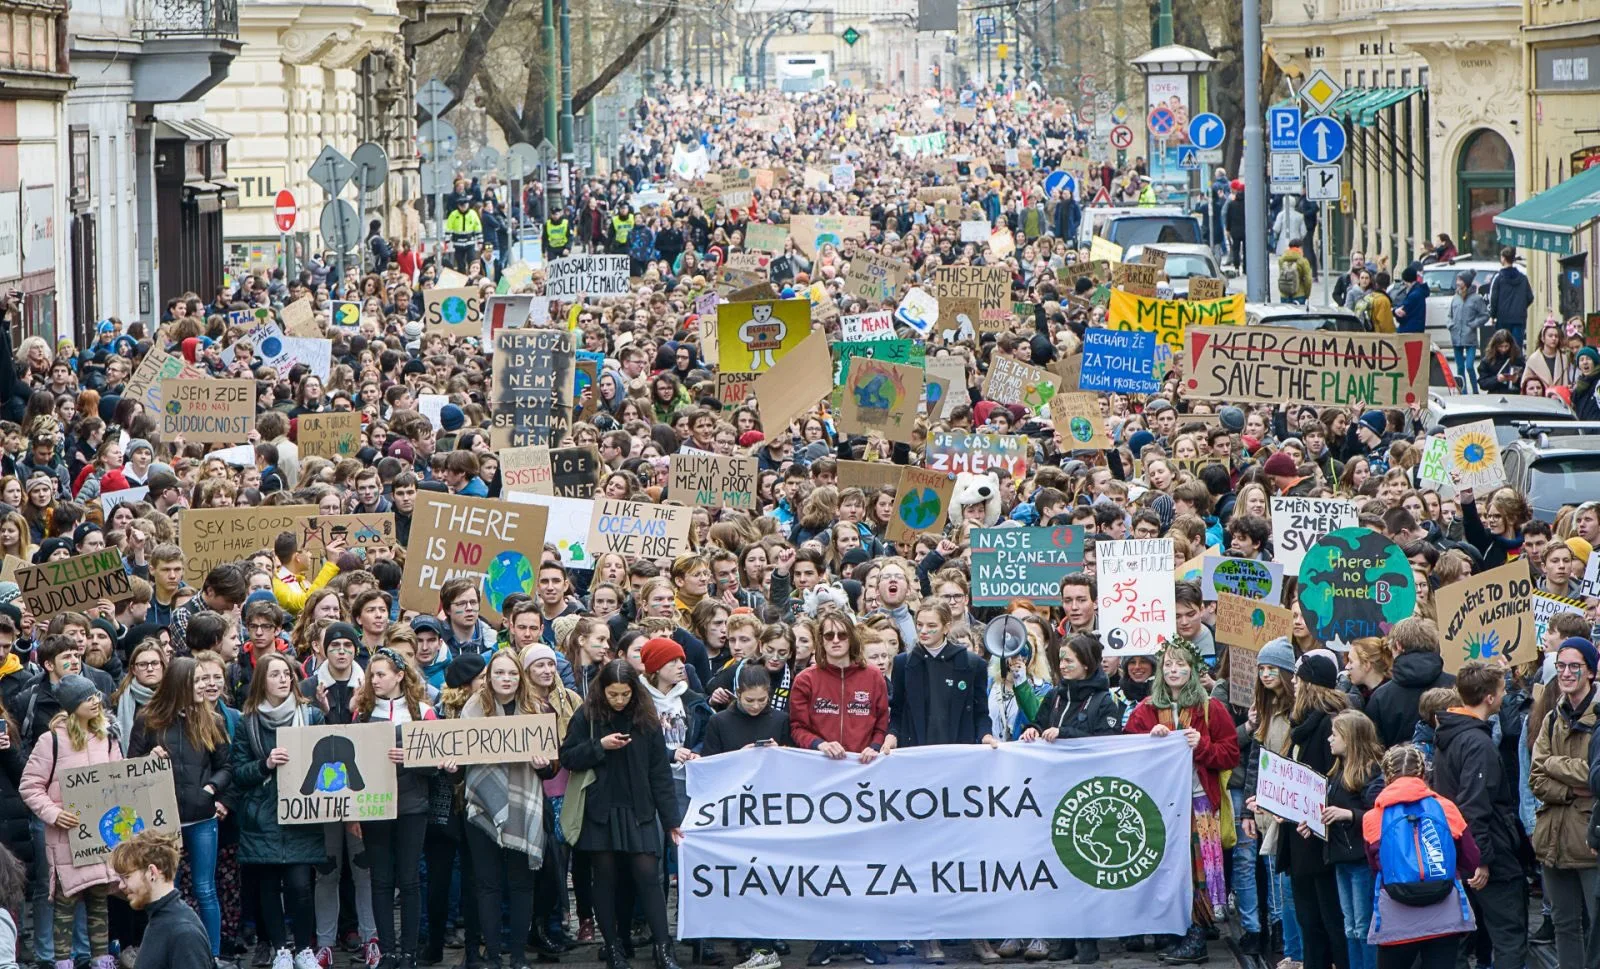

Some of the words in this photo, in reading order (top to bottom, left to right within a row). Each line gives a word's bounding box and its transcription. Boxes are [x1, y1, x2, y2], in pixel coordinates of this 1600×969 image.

[1276, 112, 1295, 138] P
[234, 176, 277, 197] TIL
[731, 256, 757, 266] MAKE
[866, 264, 887, 277] FOR
[937, 267, 969, 284] THIS
[971, 267, 1012, 284] PLANET
[938, 283, 949, 297] IS
[951, 283, 1006, 300] GETTING
[980, 299, 1001, 310] HAN
[861, 316, 889, 331] MEAN
[501, 332, 572, 354] NEMŮŽU
[1086, 331, 1129, 349] NECHÁPU
[1131, 333, 1147, 349] ŽE
[888, 343, 907, 359] SE
[1211, 332, 1277, 362] KEEP
[1280, 336, 1339, 368] CALM
[1342, 339, 1399, 373] AND
[995, 356, 1010, 371] THE
[1011, 362, 1029, 380] TEA
[1084, 352, 1102, 368] ZA
[1103, 355, 1152, 375] TOHLE
[509, 370, 557, 388] NĚMÝ
[1081, 371, 1111, 387] MUSÍM
[1209, 362, 1271, 398] SAVE
[1271, 366, 1318, 402] THE
[1320, 371, 1405, 406] PLANET
[172, 386, 210, 401] JSEM
[215, 387, 248, 401] ZDE
[515, 392, 558, 410] KDYŽ
[188, 401, 207, 412] PRO
[164, 414, 251, 435] BUDOUCNOST
[303, 418, 322, 431] OUR
[495, 414, 514, 428] SE
[522, 415, 569, 431] KLIMA
[934, 435, 952, 448] JE
[963, 434, 991, 449] ČAS
[1000, 436, 1018, 450] NA
[553, 454, 586, 474] ÍCE
[676, 456, 720, 474] KLIMA
[728, 459, 747, 478] SE
[931, 451, 1018, 474] ZMĚNY
[504, 465, 551, 486] SYSTÉM
[721, 474, 754, 493] PROČ
[695, 491, 717, 505] NE
[1274, 498, 1309, 514] ZMĚŇ
[602, 501, 644, 518] LIKE
[653, 507, 676, 521] THE
[193, 518, 225, 539] SEX
[231, 518, 244, 532] IS
[247, 515, 294, 533] GOOD
[428, 501, 520, 542] THERE
[598, 516, 667, 537] OCEANS
[1290, 513, 1342, 532] ZMĚŇ
[194, 538, 216, 553] BUT
[223, 536, 254, 550] HAVE
[605, 533, 635, 554] WE
[641, 536, 679, 558] RISE
[979, 530, 1032, 550] NAŠE
[425, 536, 446, 561] IS
[453, 541, 483, 566] NO
[997, 550, 1069, 565] PLANETA
[1328, 549, 1371, 569] there
[1375, 554, 1387, 569] is
[18, 564, 51, 593] ZA
[49, 549, 122, 587] ZELENOU
[979, 563, 1027, 580] NAŠE
[1342, 571, 1362, 583] no
[980, 582, 1061, 597] BUDOUCNO
[1324, 582, 1370, 601] planet
[1375, 580, 1392, 605] B
[1445, 586, 1485, 642] VEZMĚME
[1486, 583, 1504, 601] TO
[1509, 578, 1531, 599] DO
[1478, 596, 1531, 627] VLASTNÍCH
[406, 725, 557, 761] #AKCEPROKLIMA
[65, 770, 100, 789] SAVE
[126, 757, 172, 778] PLANET
[280, 798, 320, 821] JOIN
[325, 795, 350, 818] THE
[356, 791, 394, 805] GREEN
[359, 804, 385, 817] SIDE
[694, 777, 1043, 829] STŘEDOŠKOLSKÁ
[1055, 780, 1105, 836] FRIDAYS
[1110, 780, 1143, 804] FOR
[153, 808, 167, 827] &
[78, 823, 93, 840] &
[1095, 847, 1159, 885] FUTURE
[692, 857, 852, 898] STÁVKA
[865, 863, 917, 896] ZA
[931, 859, 1058, 894] KLIMA
